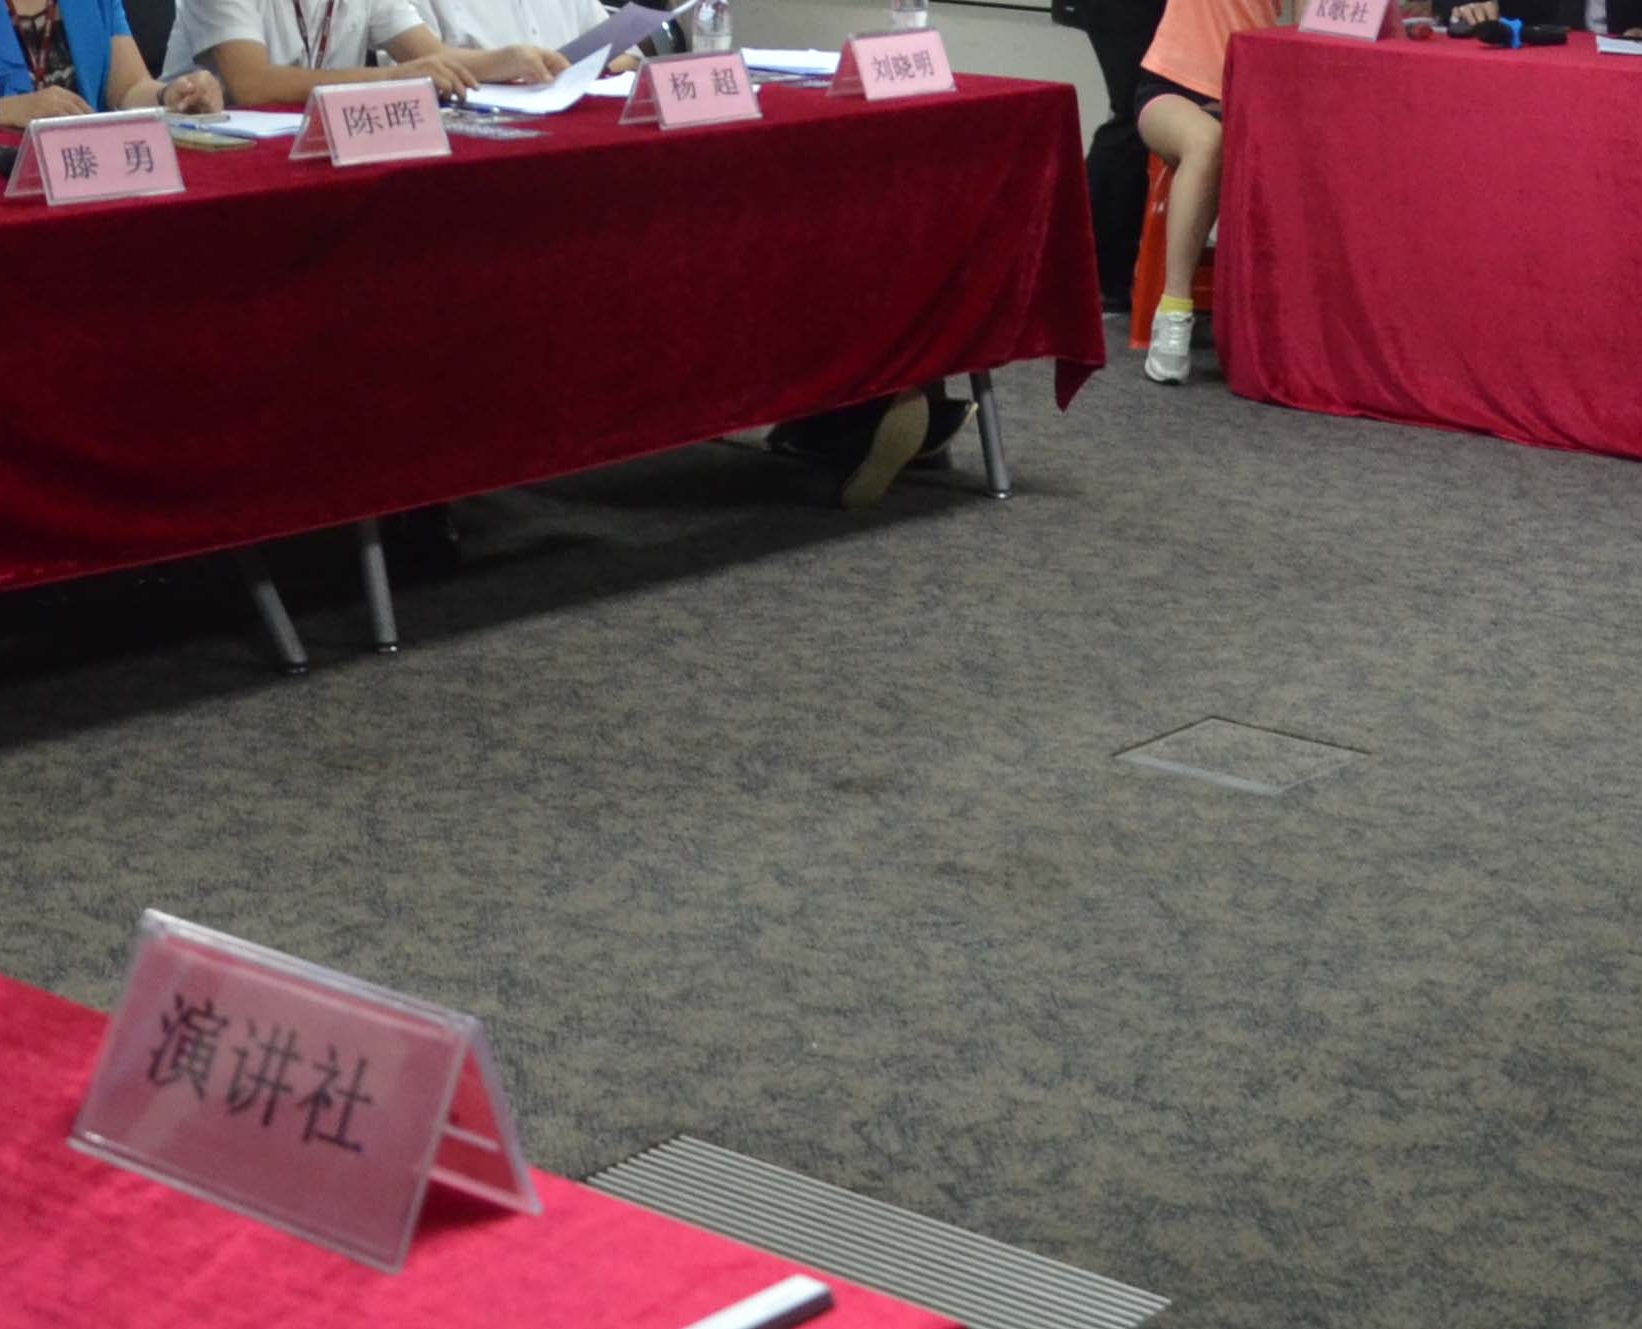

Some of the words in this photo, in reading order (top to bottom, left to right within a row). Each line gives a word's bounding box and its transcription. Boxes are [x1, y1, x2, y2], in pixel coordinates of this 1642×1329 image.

[670, 68, 740, 102] 杨超
[871, 50, 935, 82] 刘晓明
[340, 98, 425, 138] 陈晖
[61, 140, 154, 182] 滕勇
[146, 992, 373, 1154] 演讲社
